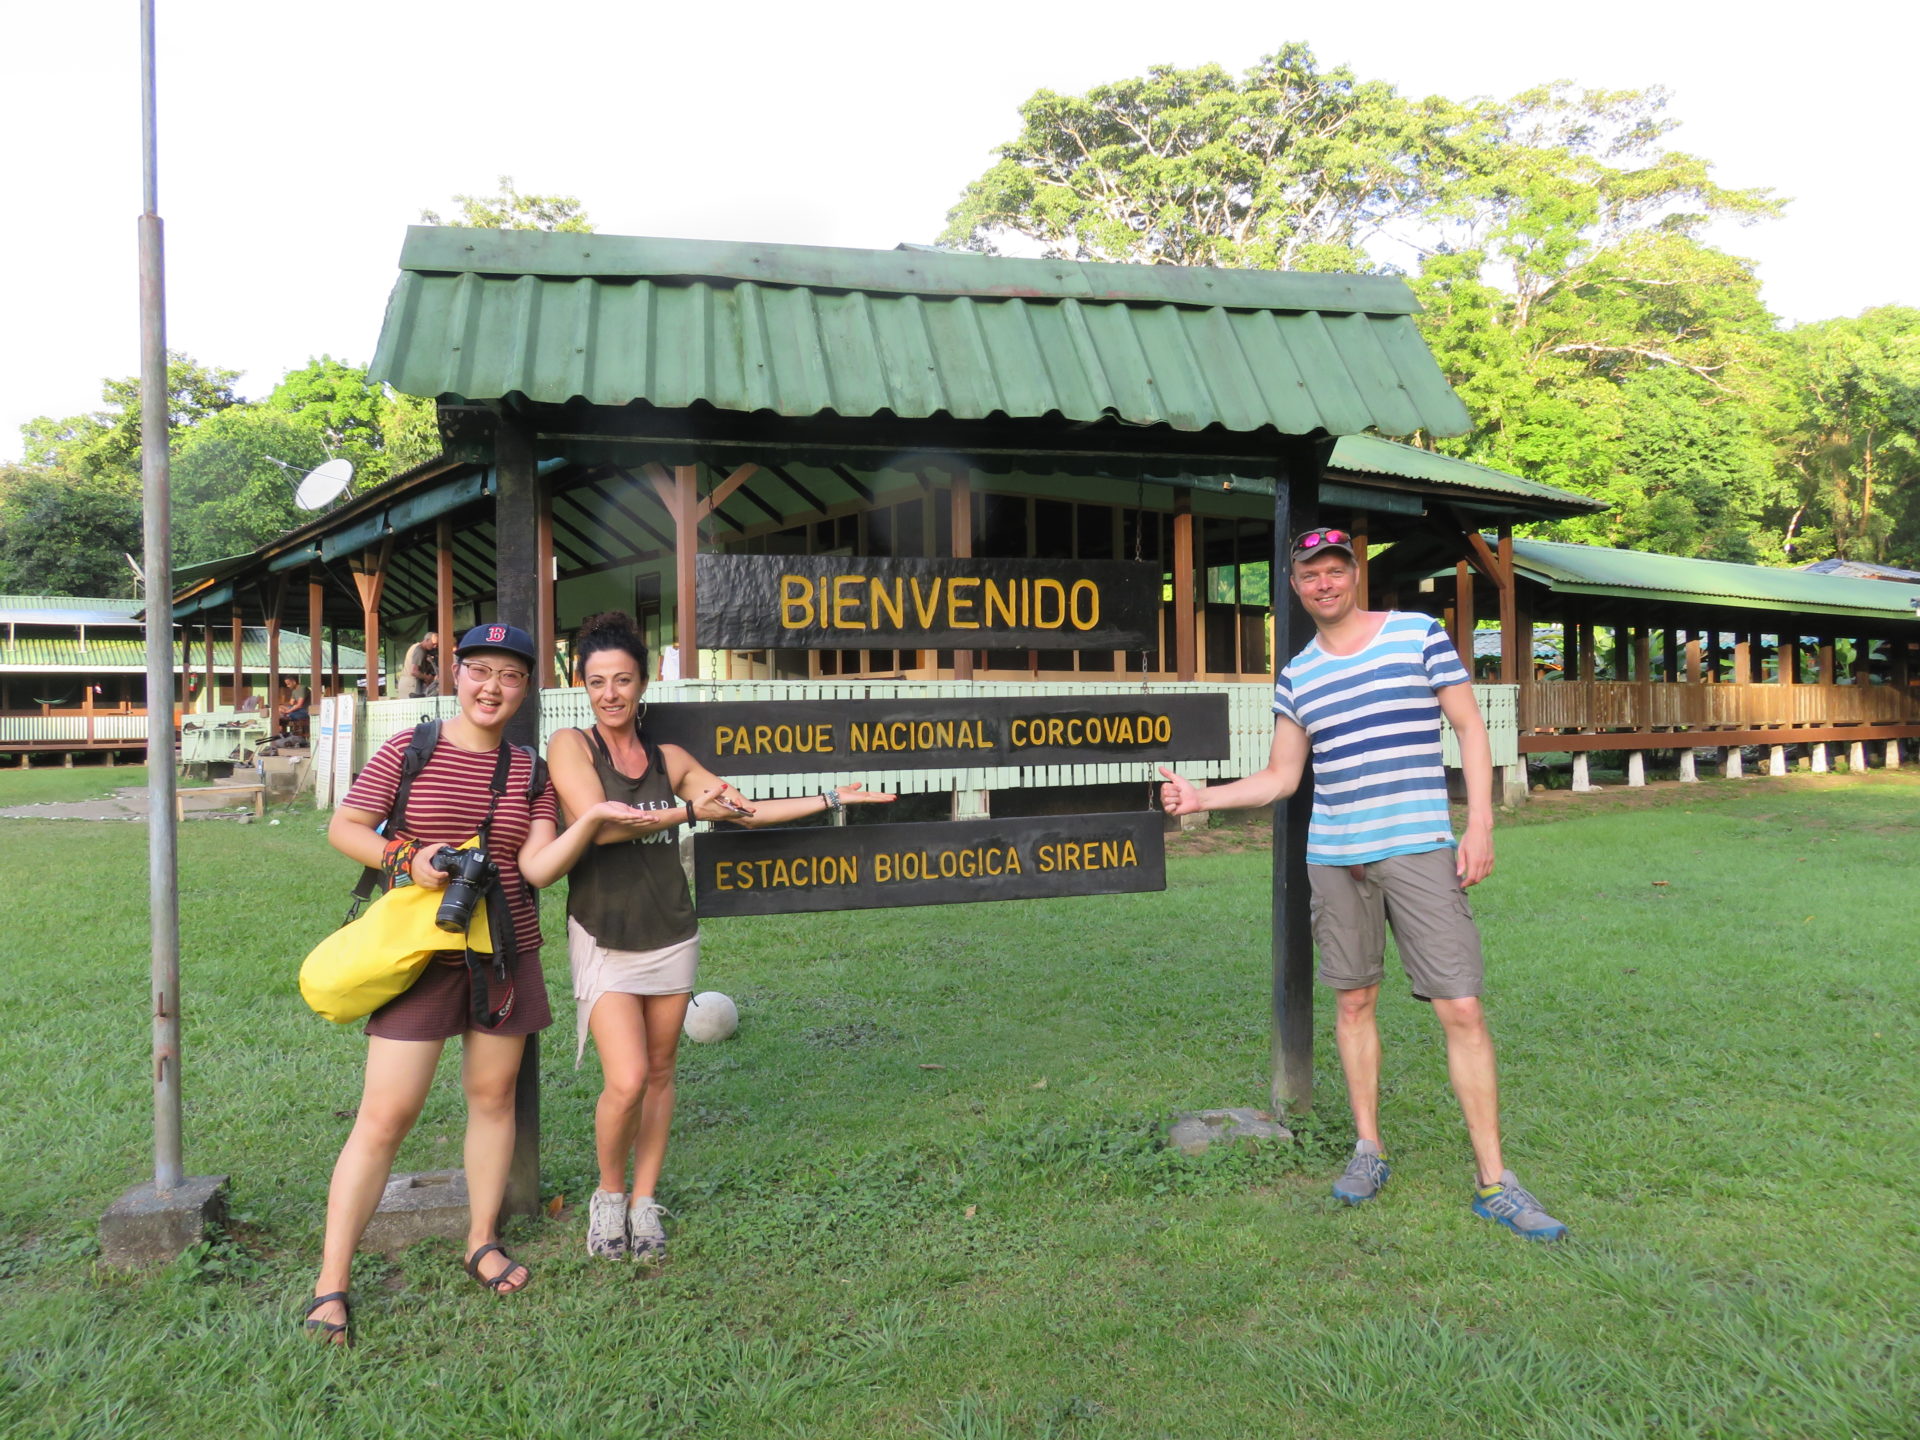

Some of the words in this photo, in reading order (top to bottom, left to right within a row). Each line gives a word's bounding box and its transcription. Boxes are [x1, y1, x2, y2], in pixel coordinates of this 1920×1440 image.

[780, 574, 1100, 631] BIENVENIDO
[486, 626, 506, 643] B
[715, 723, 834, 755] PARQUE
[850, 720, 994, 752] NACIONAL
[1011, 715, 1172, 747] CORCOVADO
[716, 855, 858, 891] ESTACION
[874, 847, 1022, 883] BIOLOGICA
[1038, 839, 1138, 872] SIRENA
[498, 987, 515, 1017] Can
